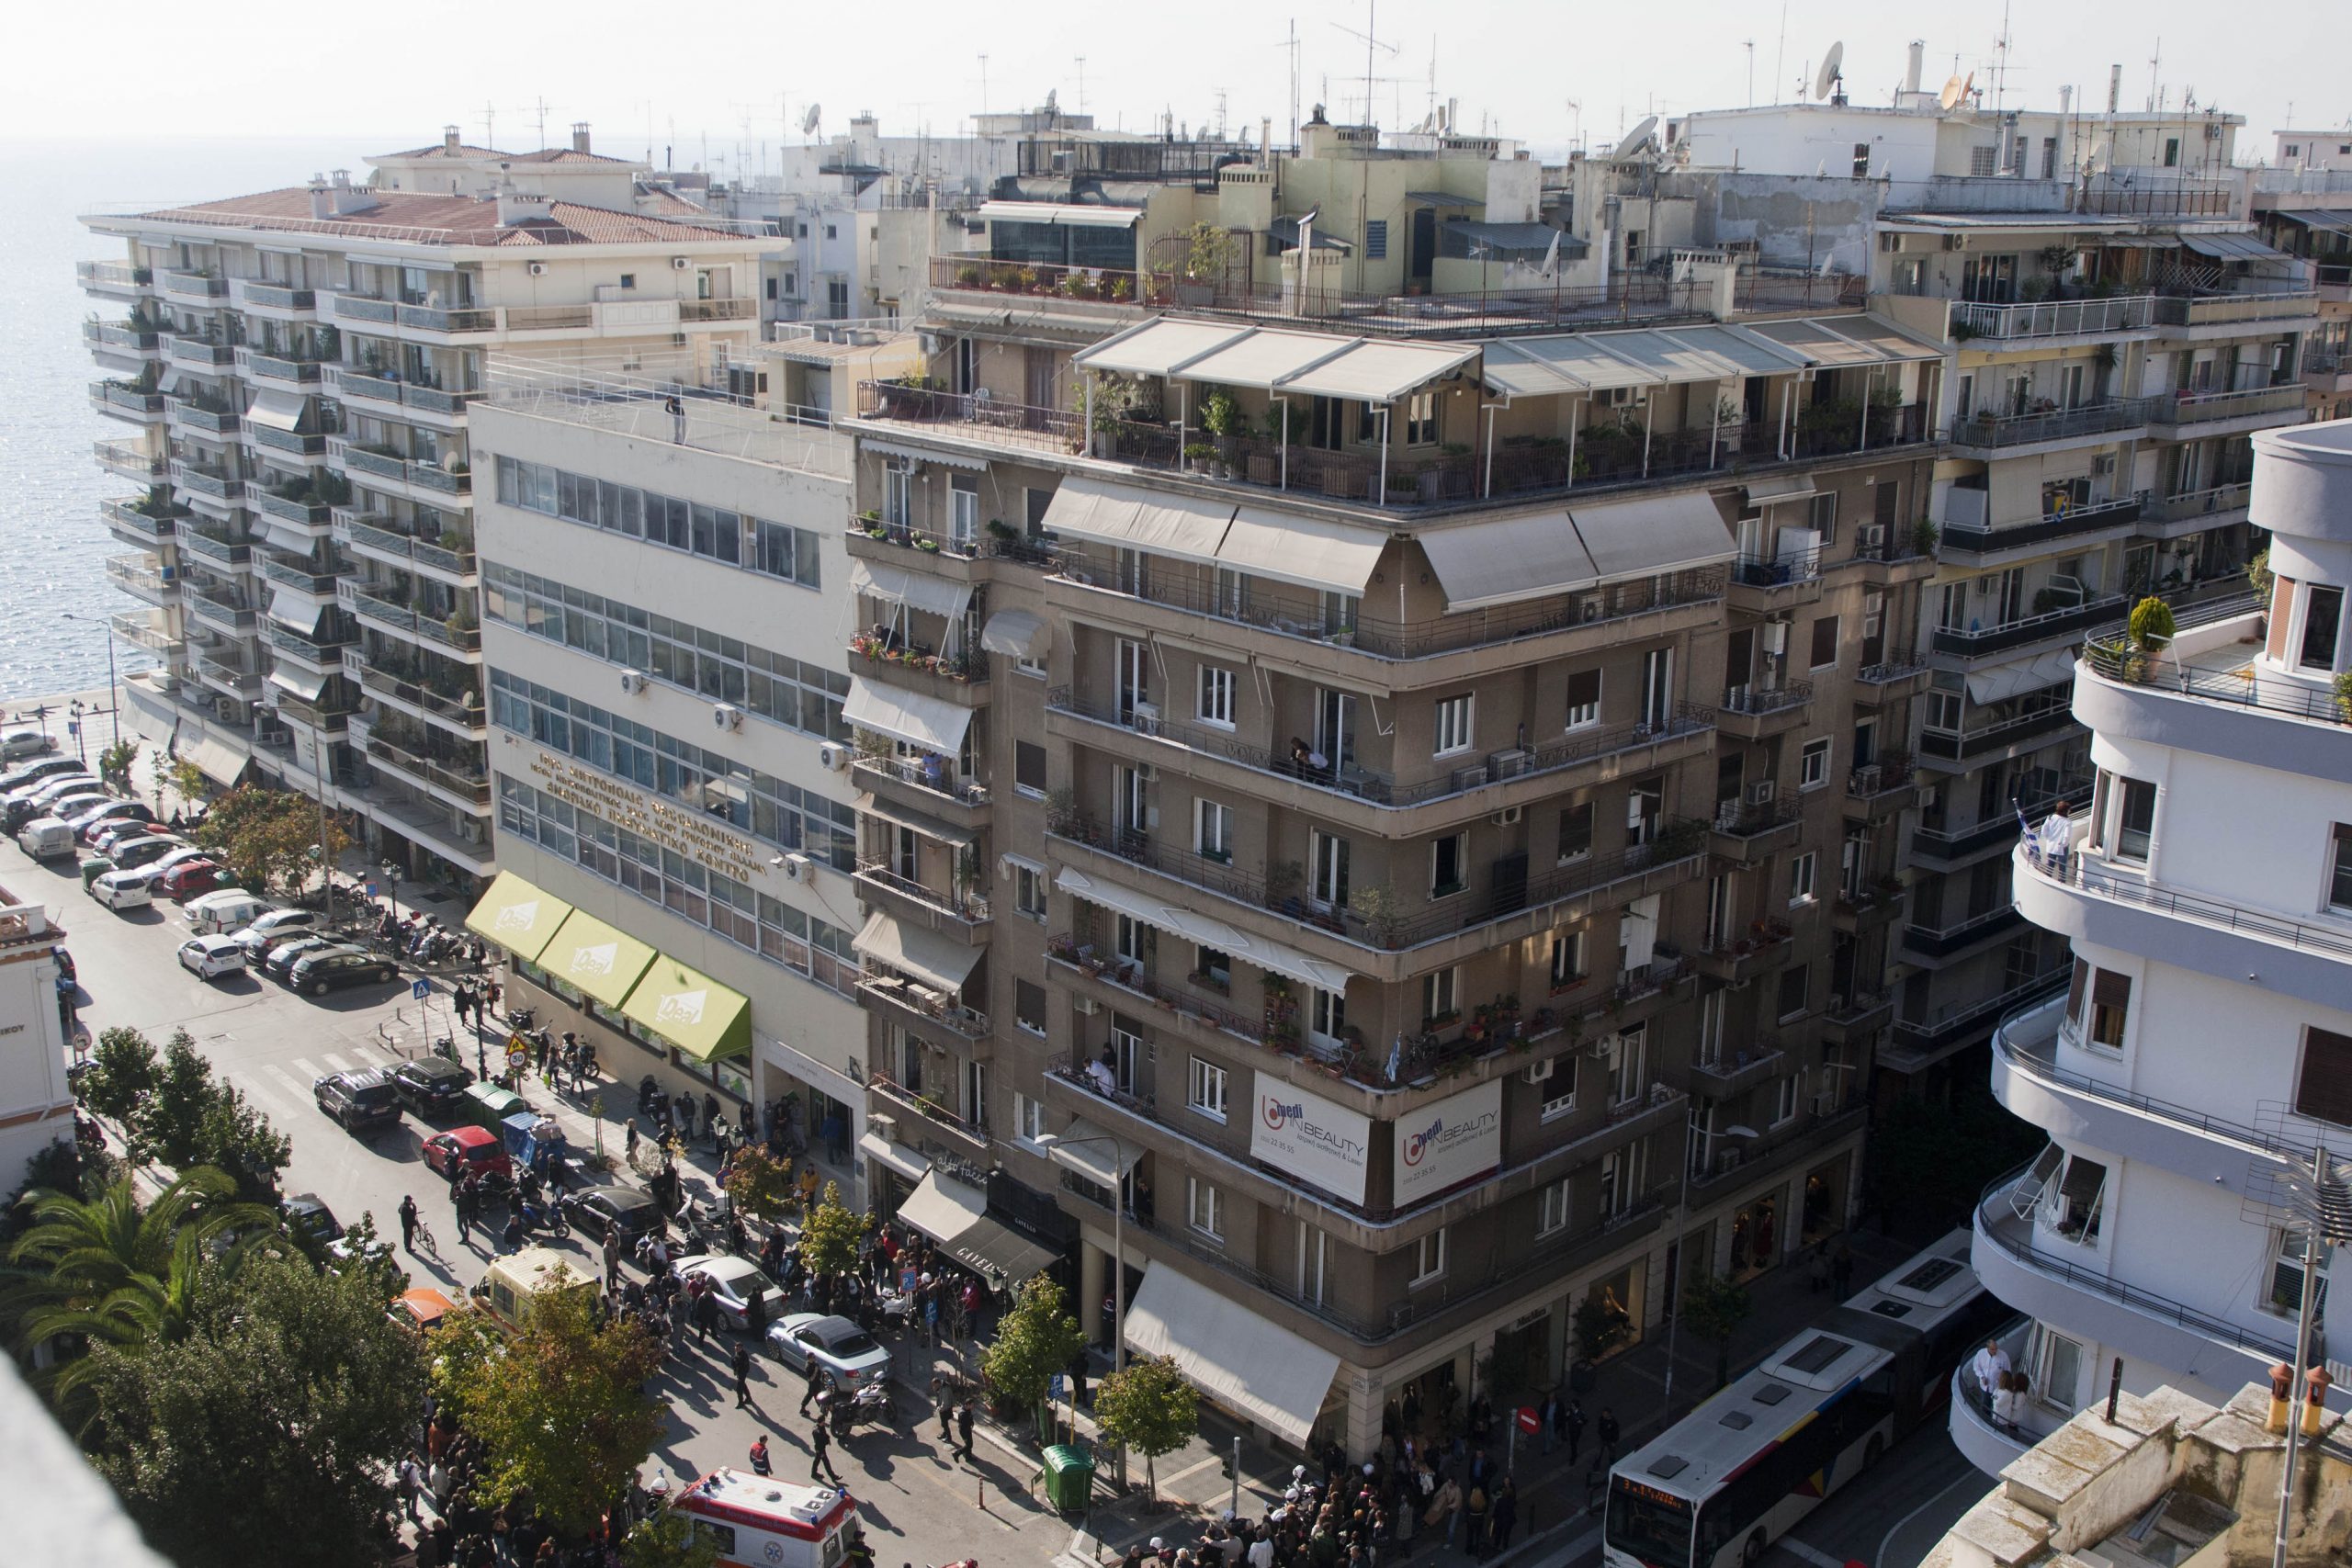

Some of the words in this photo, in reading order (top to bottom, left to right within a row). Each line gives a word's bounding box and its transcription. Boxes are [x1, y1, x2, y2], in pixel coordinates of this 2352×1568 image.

[662, 998, 699, 1024] Deal
[0, 1024, 25, 1035] ΙΚΟΥ
[512, 1055, 524, 1063] 30
[1276, 1104, 1303, 1119] medi
[1418, 1118, 1442, 1148] medi
[937, 1155, 959, 1171] alto
[1014, 1217, 1036, 1234] GAVELLO
[956, 1247, 1009, 1277] GAVELO
